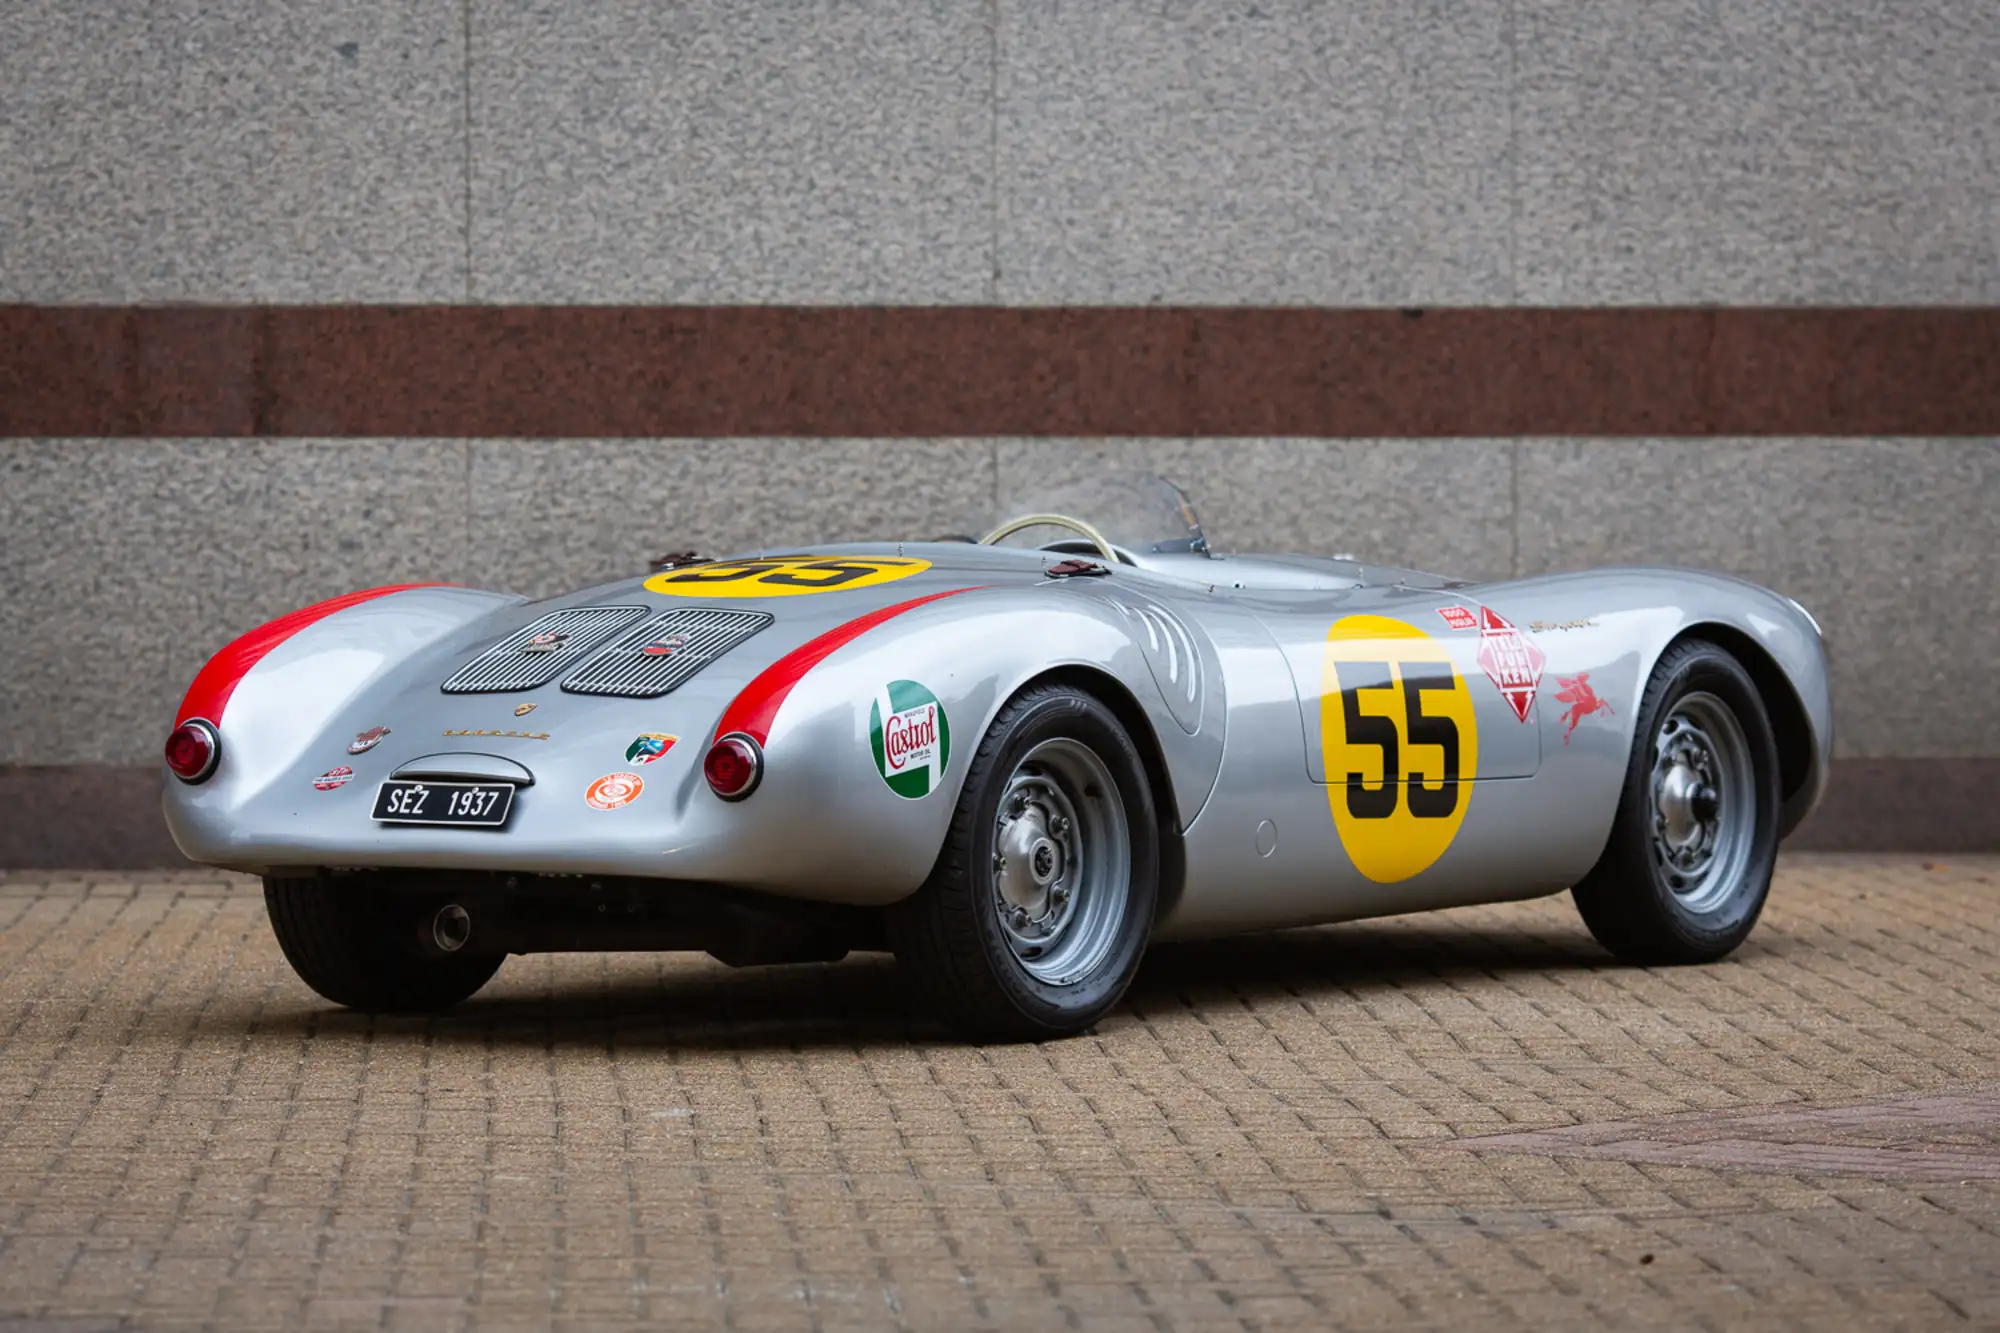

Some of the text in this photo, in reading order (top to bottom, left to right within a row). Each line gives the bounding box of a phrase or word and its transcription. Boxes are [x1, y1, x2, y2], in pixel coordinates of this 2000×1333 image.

[886, 705, 936, 769] Castrol
[1334, 661, 1459, 819] 55
[387, 788, 500, 816] SEZ 1937
